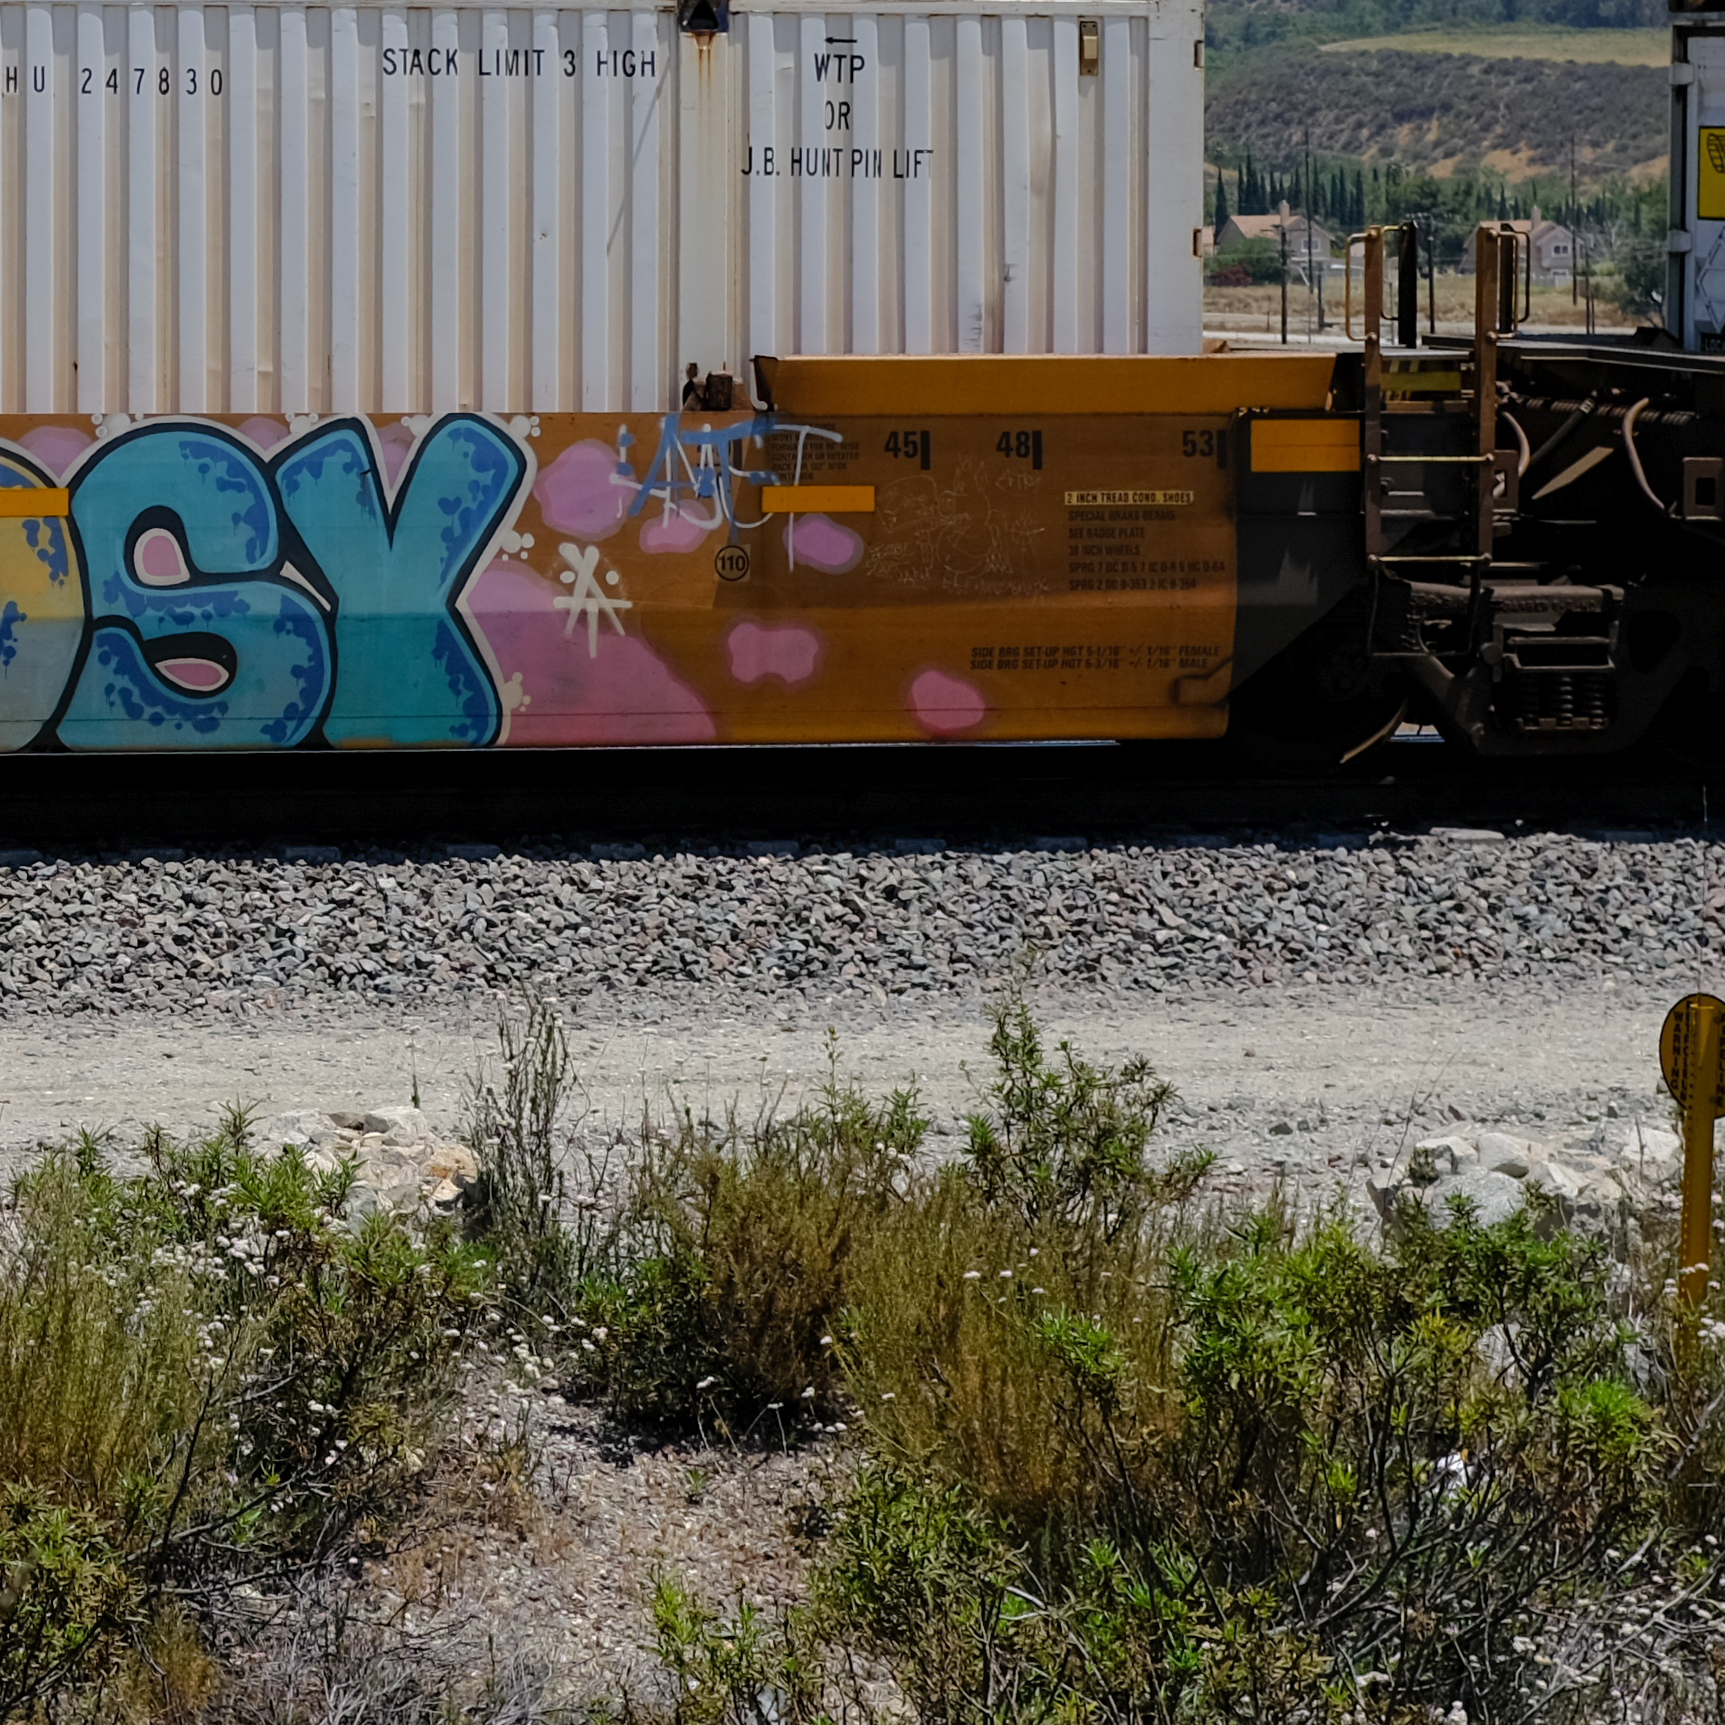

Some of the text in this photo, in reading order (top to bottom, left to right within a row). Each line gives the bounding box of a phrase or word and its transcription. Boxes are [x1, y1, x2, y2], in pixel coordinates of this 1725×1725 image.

[382, 47, 657, 78] STACK LIMIT 3 HIGH
[813, 53, 866, 85] WTP
[824, 100, 851, 131] OR
[741, 147, 781, 177] J.B.
[790, 147, 845, 179] HUNT
[851, 148, 883, 179] PIN
[884, 430, 919, 460] 45
[996, 429, 1031, 459] 48
[1181, 429, 1216, 459] 53
[1101, 492, 1129, 503] TREAD
[1118, 526, 1145, 539] PLATE
[718, 555, 746, 572] 110
[1670, 1011, 1684, 1090] WARNING
